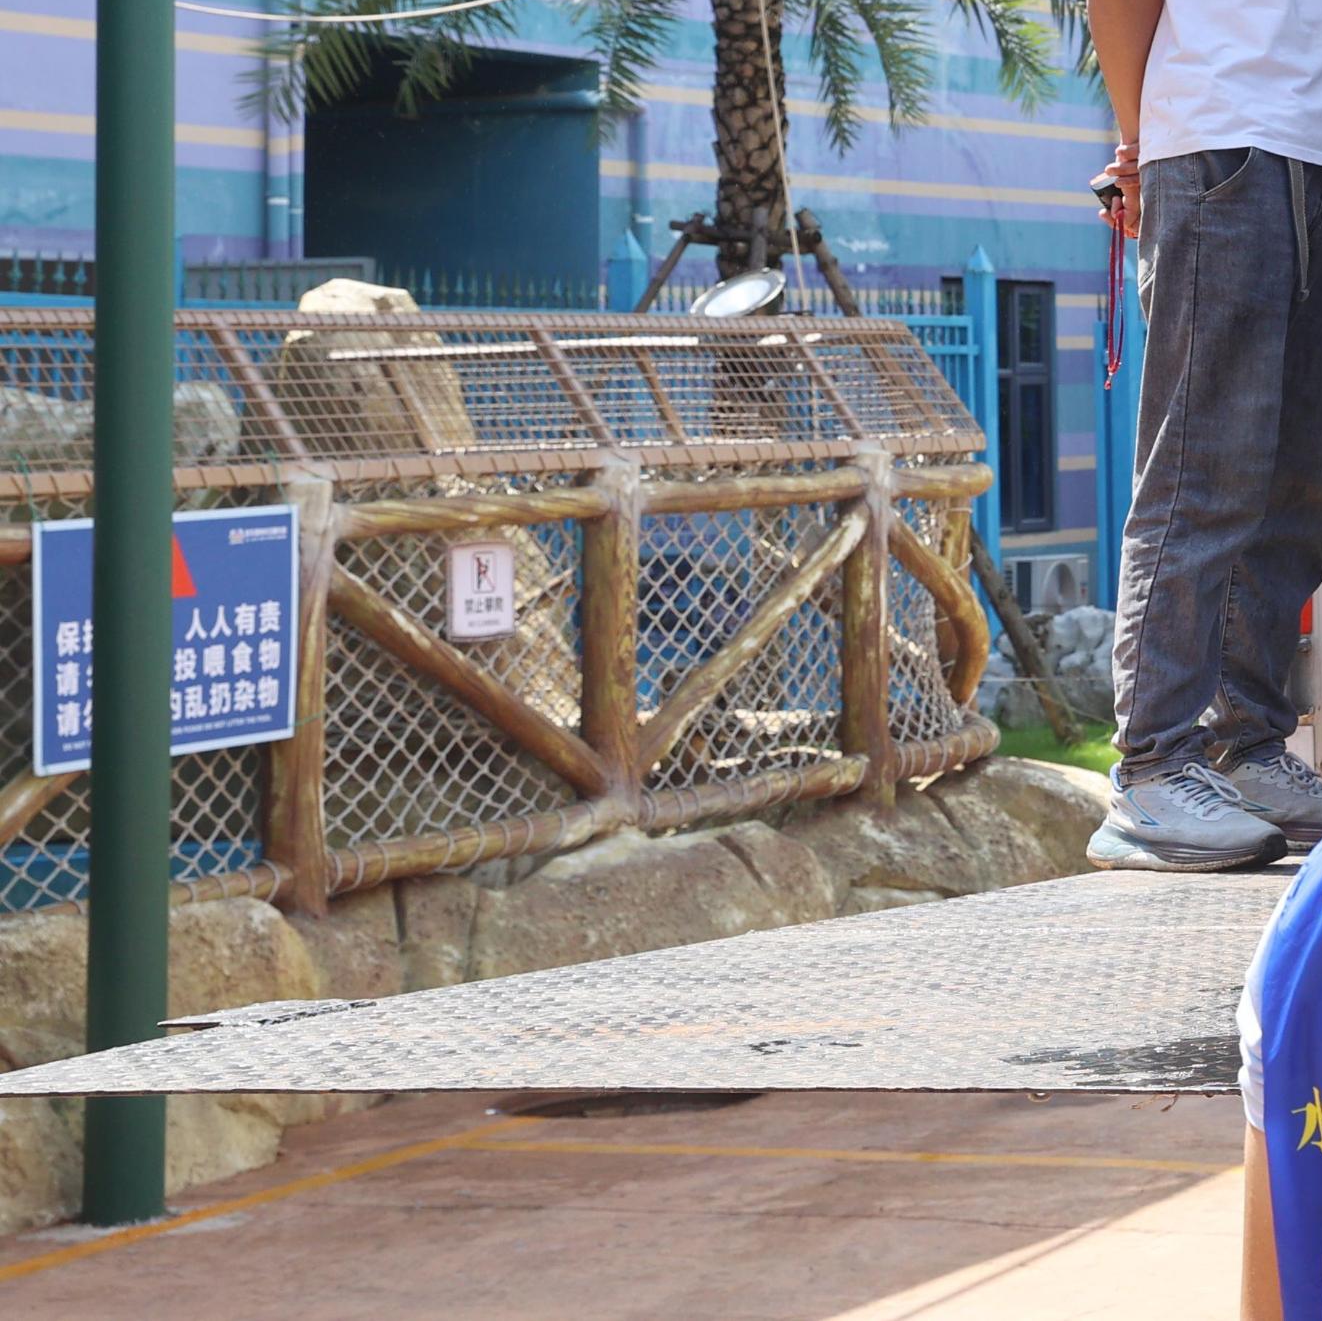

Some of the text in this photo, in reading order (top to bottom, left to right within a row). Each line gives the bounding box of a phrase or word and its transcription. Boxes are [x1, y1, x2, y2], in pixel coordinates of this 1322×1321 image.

[185, 600, 281, 641] 人人有责
[174, 639, 281, 681] 投喂食物
